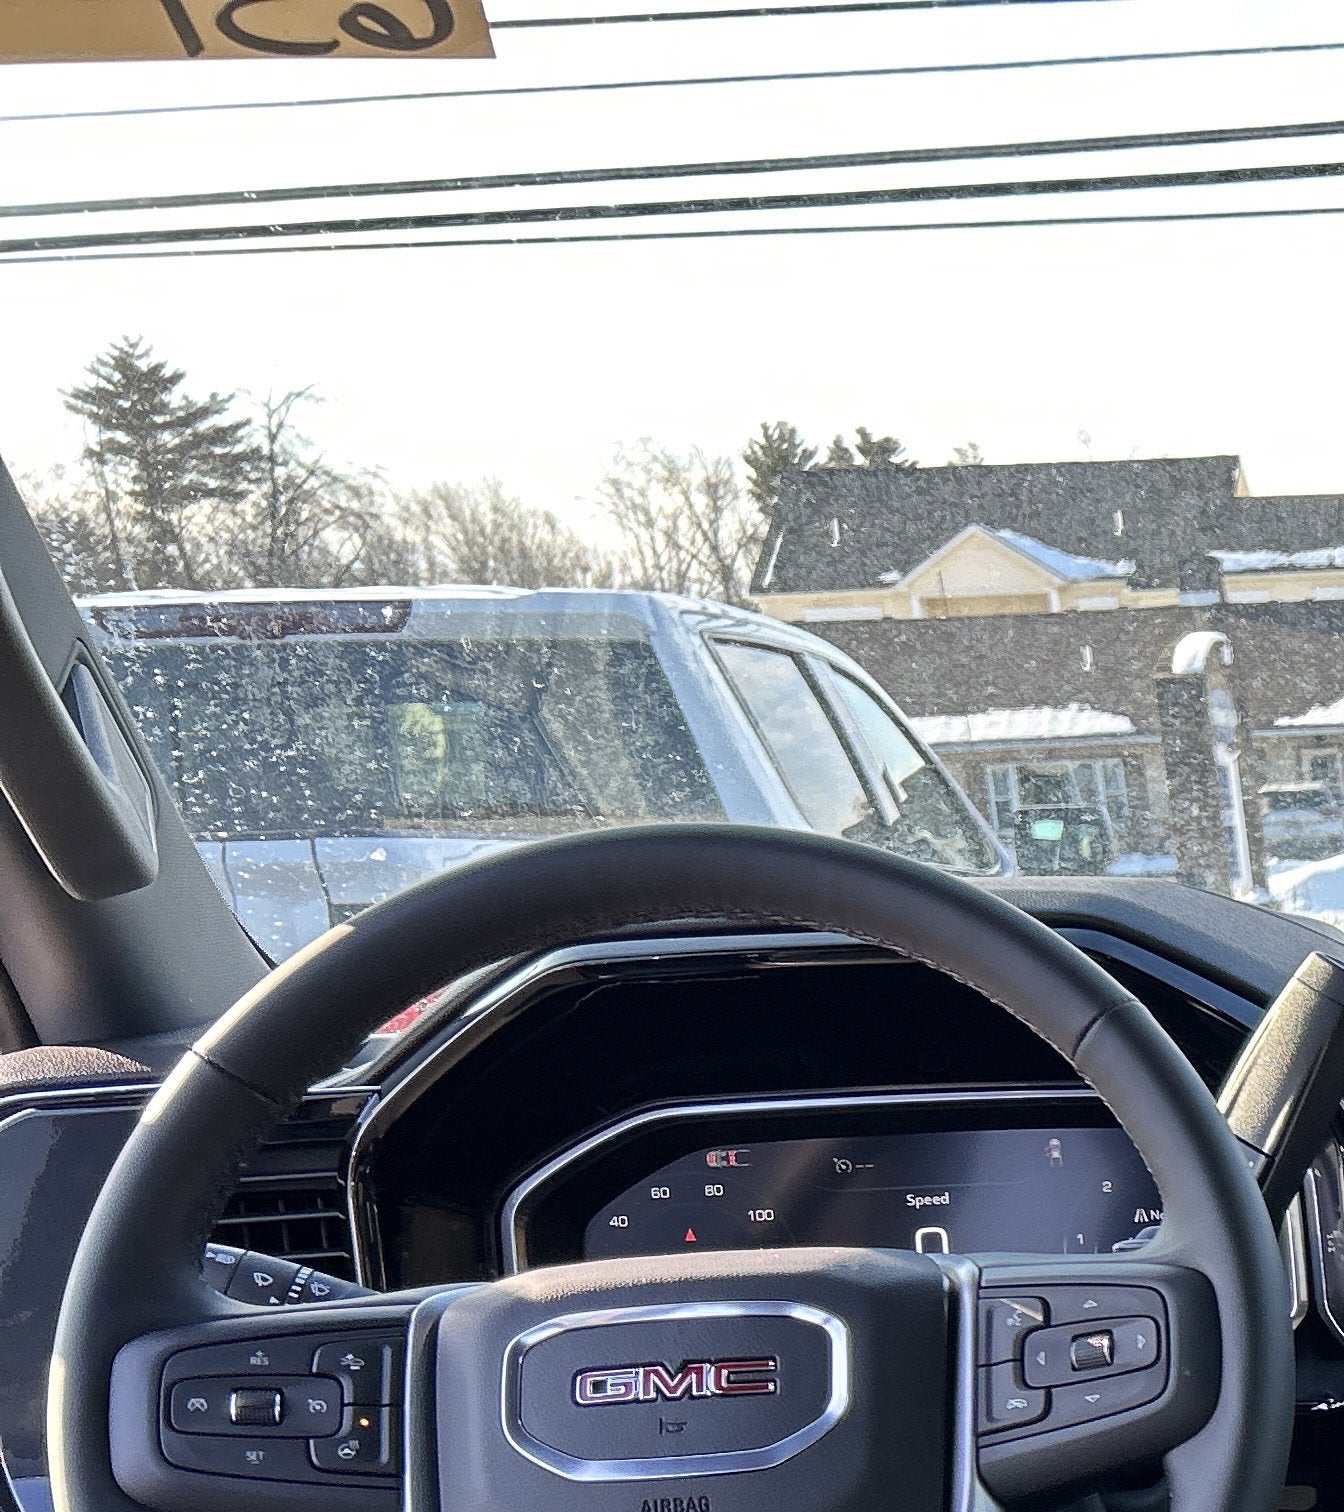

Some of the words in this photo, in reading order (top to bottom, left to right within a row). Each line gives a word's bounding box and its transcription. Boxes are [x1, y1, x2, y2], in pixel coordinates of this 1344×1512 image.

[651, 1187, 670, 1199] 60
[704, 1184, 724, 1197] 80
[1102, 1181, 1113, 1193] 2
[906, 1192, 950, 1209] Speed
[609, 1215, 629, 1227] 40
[747, 1209, 775, 1222] 100
[1076, 1233, 1084, 1245] 1
[576, 1359, 776, 1405] GMC
